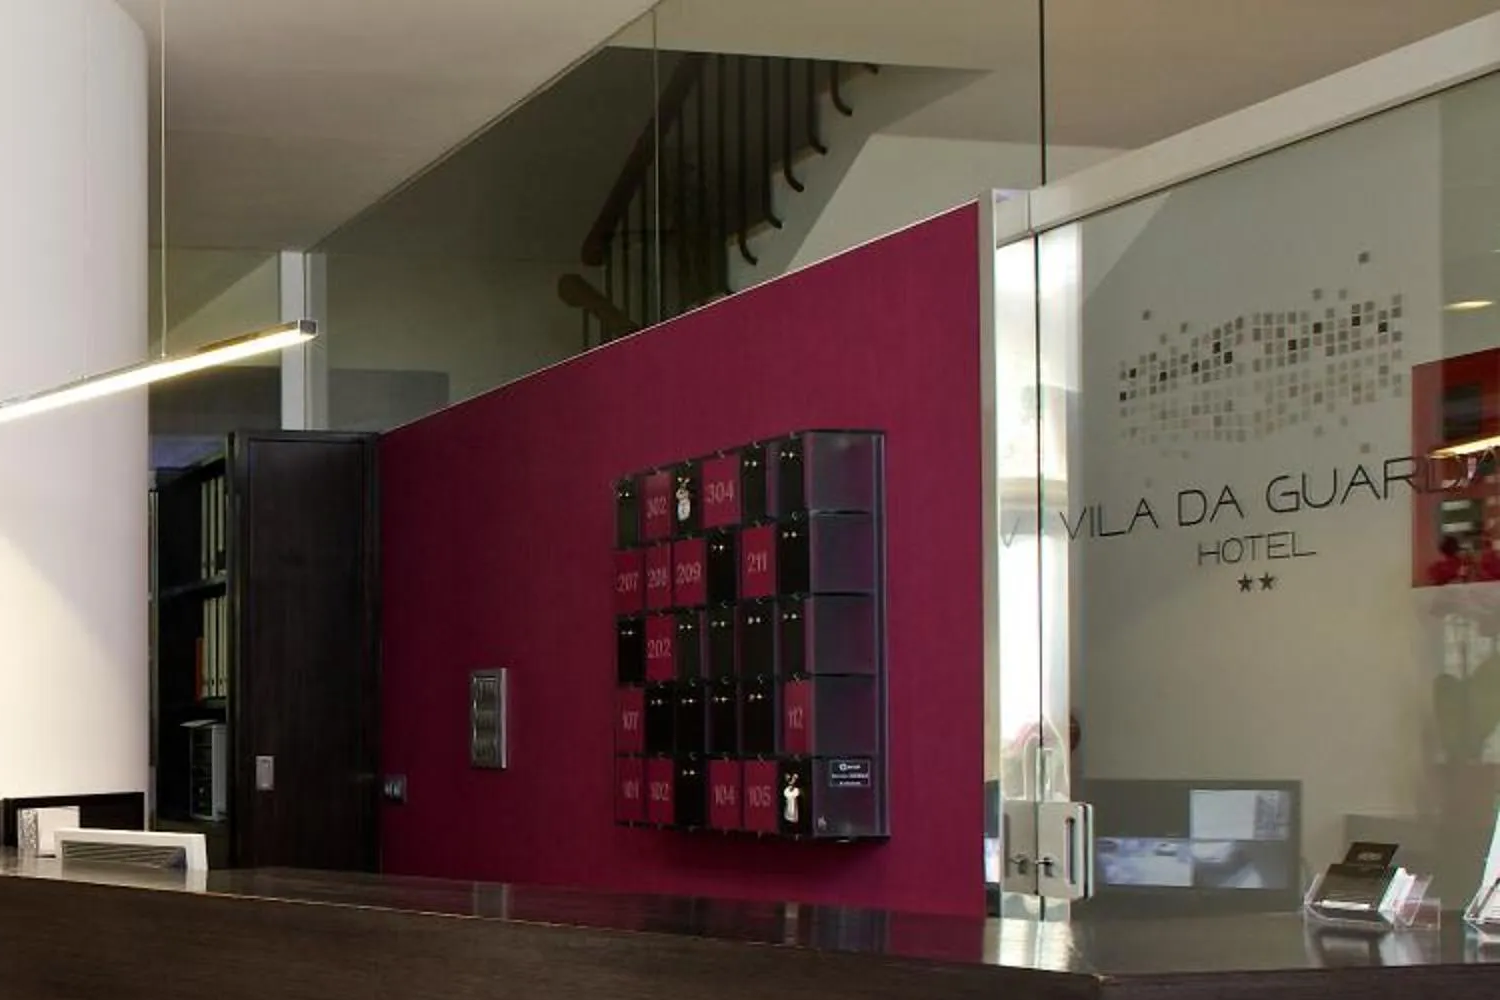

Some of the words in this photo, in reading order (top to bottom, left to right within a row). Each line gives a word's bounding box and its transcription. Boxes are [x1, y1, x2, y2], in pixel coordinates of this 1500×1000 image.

[706, 481, 735, 504] 304
[1059, 497, 1160, 541] VILA
[1177, 484, 1245, 527] DA
[1197, 531, 1318, 567] HOTEL
[617, 572, 640, 594] 207
[675, 560, 702, 585] 209
[747, 549, 768, 574] 211
[647, 638, 672, 660] 202
[713, 783, 737, 806] 104
[748, 784, 772, 807] 105
